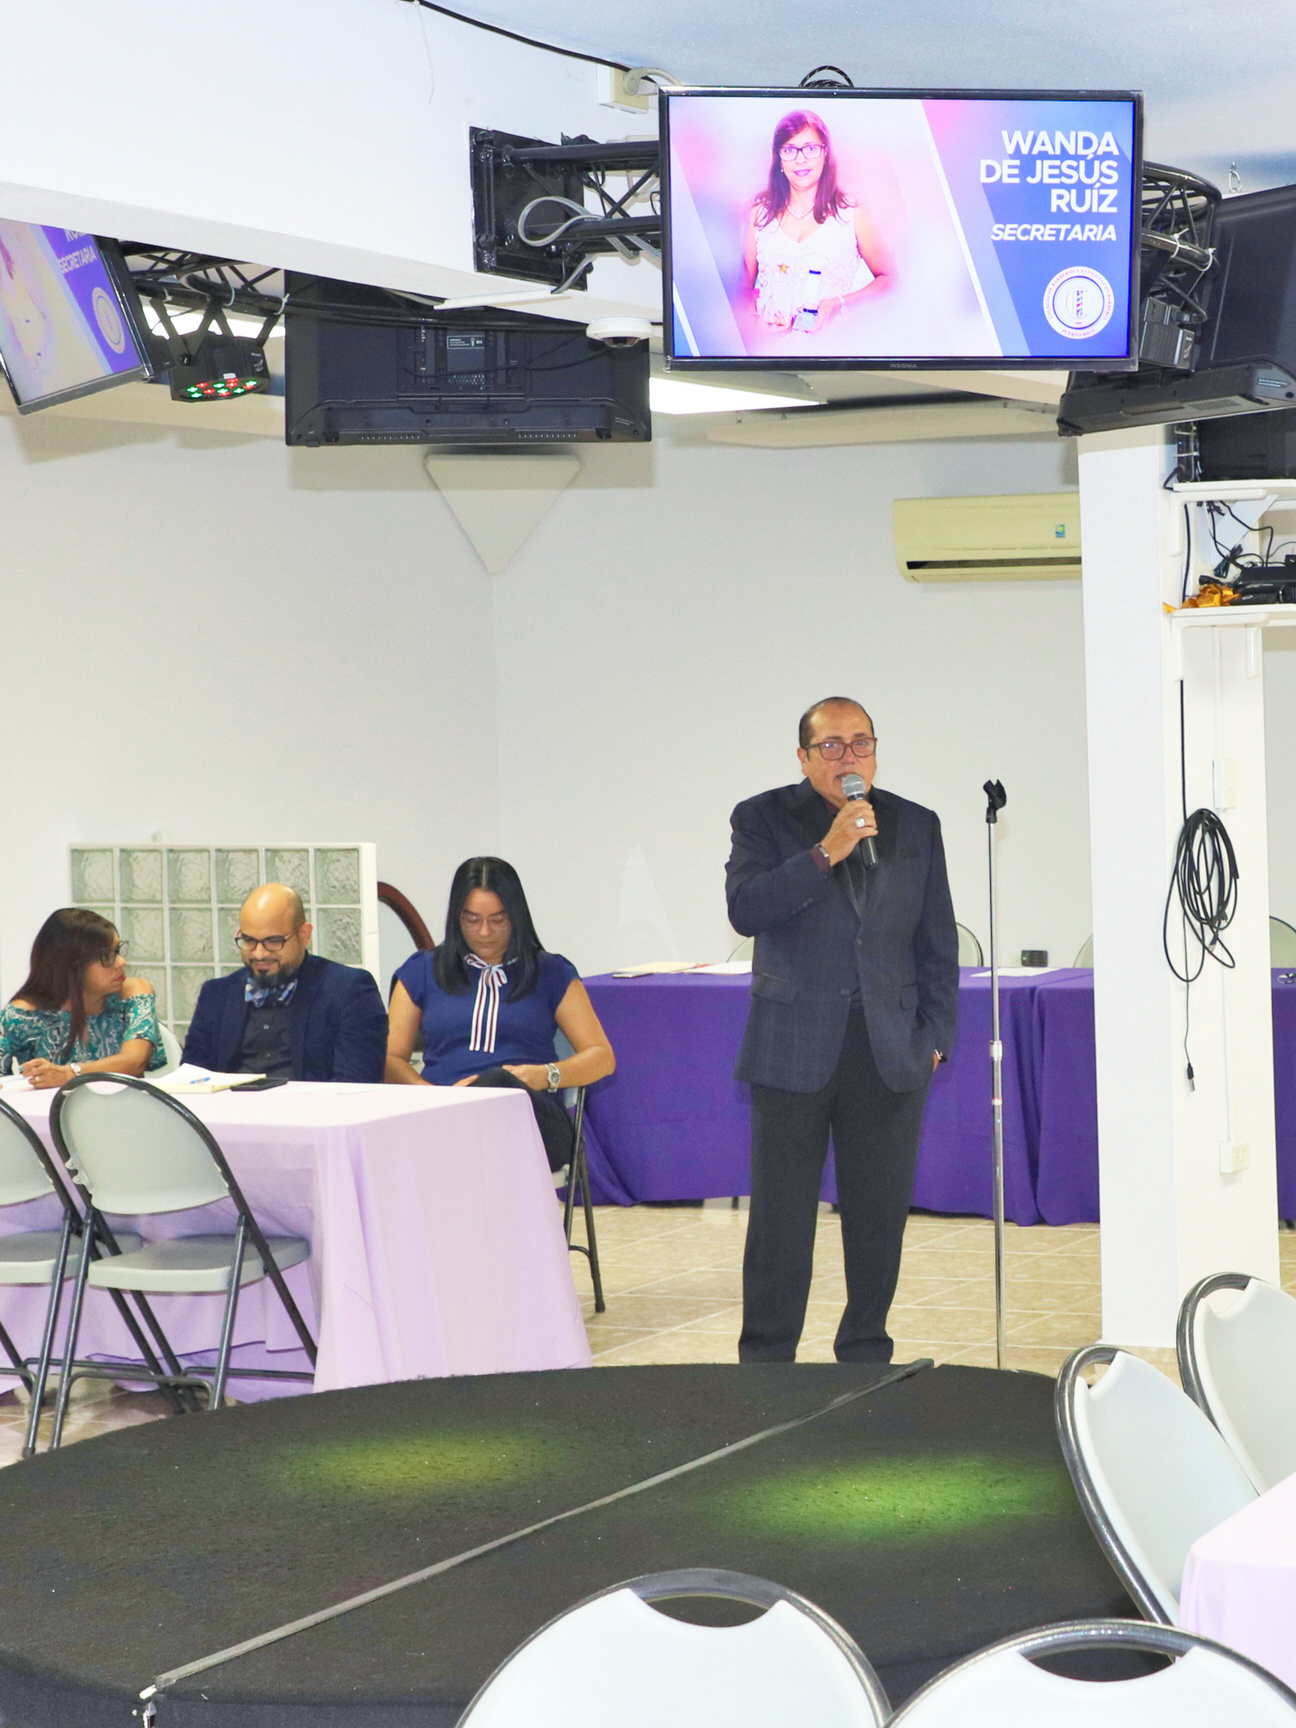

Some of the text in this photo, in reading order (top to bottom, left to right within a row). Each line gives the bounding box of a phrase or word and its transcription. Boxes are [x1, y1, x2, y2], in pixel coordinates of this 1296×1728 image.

[1001, 130, 1120, 156] WANDA
[980, 153, 1119, 185] DE JESÚS
[1050, 182, 1118, 213] RUÍZ
[990, 223, 1117, 242] SECRETARIA
[59, 245, 97, 274] SECRETARIA
